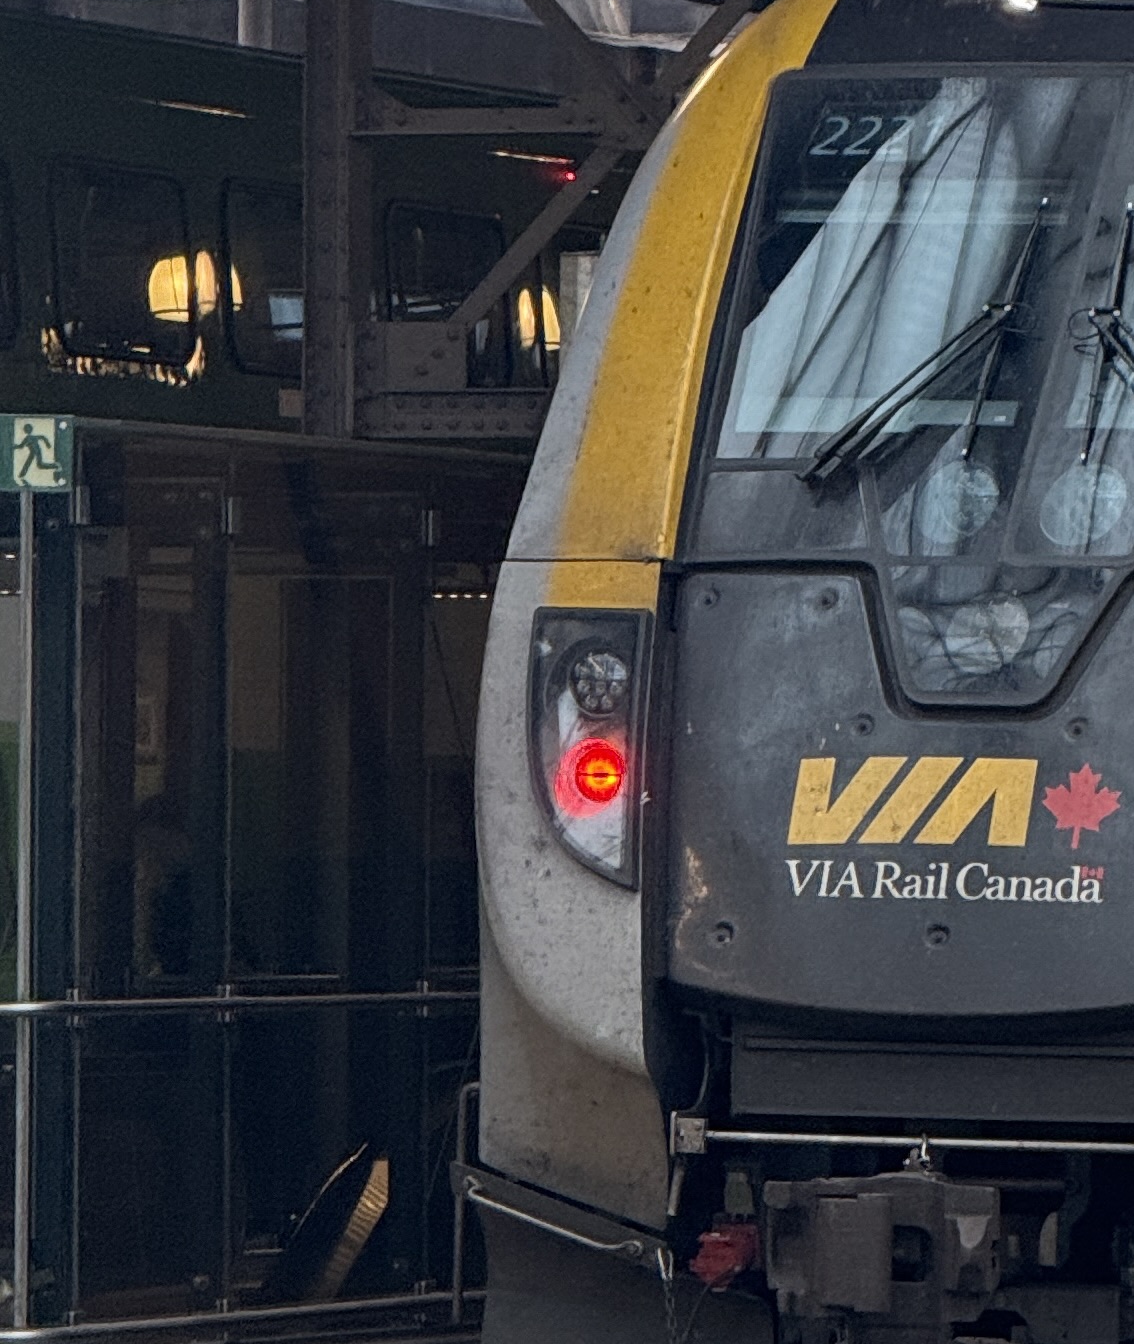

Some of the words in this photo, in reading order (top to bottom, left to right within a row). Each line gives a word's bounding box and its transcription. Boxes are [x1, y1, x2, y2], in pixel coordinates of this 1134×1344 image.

[809, 114, 946, 156] 2221
[786, 756, 1038, 847] VIA
[784, 859, 864, 899] VIA
[871, 862, 949, 900] Rail
[955, 862, 1104, 903] Canada
